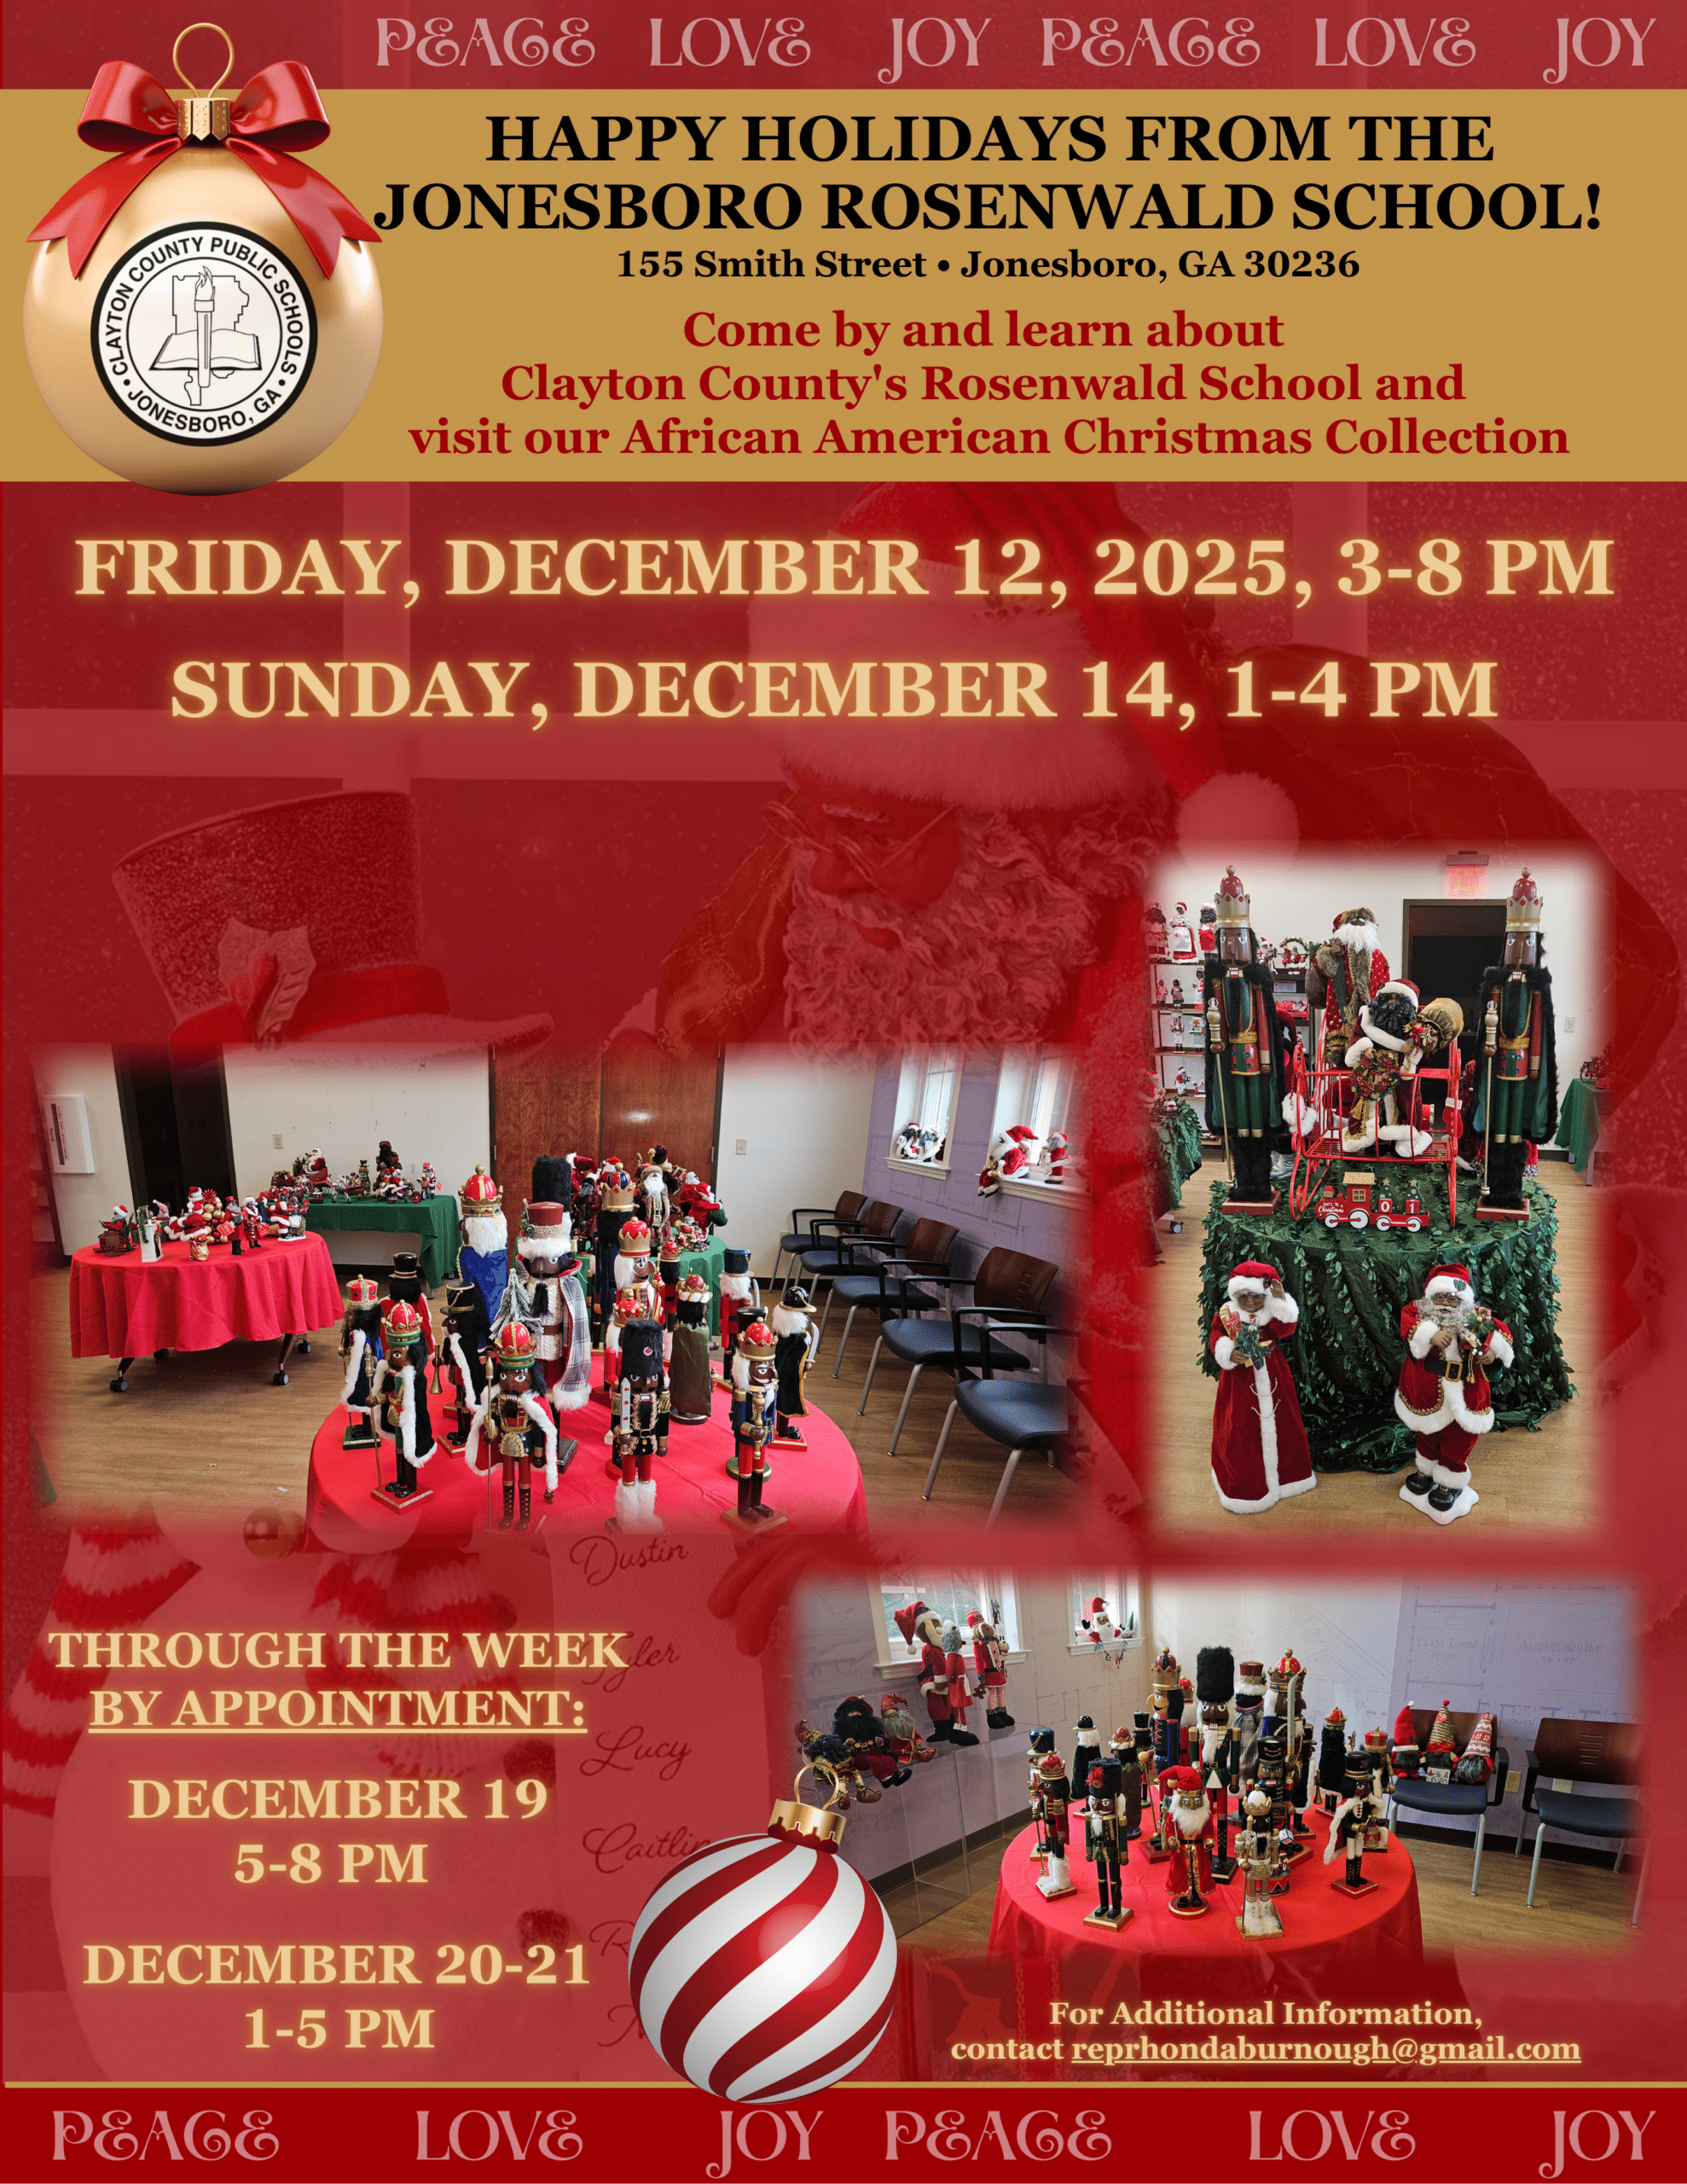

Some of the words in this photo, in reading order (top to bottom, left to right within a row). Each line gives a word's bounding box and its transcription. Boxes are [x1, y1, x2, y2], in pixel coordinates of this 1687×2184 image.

[377, 18, 594, 67] PEACE
[651, 18, 810, 67] LOVE
[878, 18, 991, 84] JOY
[1042, 18, 1260, 67] PEACE
[1316, 18, 1475, 67] LOVE
[1543, 18, 1656, 84] JOY
[486, 116, 726, 160] HAPPY
[742, 115, 1105, 161] HOLIDAYS
[1127, 115, 1330, 161] FROM
[1349, 117, 1493, 160] THE
[374, 183, 802, 229] JONESBORO
[822, 183, 1273, 229] ROSENWALD
[1293, 183, 1599, 229] SCHOOL!
[619, 251, 682, 276] 155
[695, 249, 804, 277] Smith
[816, 251, 926, 277] Street
[961, 249, 1167, 282] Jonesboro,
[1179, 251, 1235, 277] GA
[1245, 251, 1359, 277] 30236
[106, 282, 134, 375] CLAYTON
[128, 236, 204, 282] COUNTY
[210, 236, 278, 280] PUBLIC
[273, 279, 304, 375] SCHOOLS
[684, 312, 820, 346] Come
[832, 310, 890, 356] by
[903, 310, 993, 346] and
[1006, 310, 1133, 346] learn
[1147, 310, 1284, 346] about
[502, 363, 685, 410] Clayton
[699, 364, 907, 410] County's
[922, 363, 1186, 400] Rosenwald
[1200, 363, 1361, 400] School
[1377, 363, 1466, 400] and
[127, 390, 254, 433] JONESBORO,
[253, 388, 282, 414] GA
[409, 417, 511, 454] visit
[525, 429, 610, 454] our
[621, 417, 802, 454] African
[813, 417, 1050, 454] American
[1064, 417, 1312, 454] Christmas
[1326, 417, 1569, 454] Collection
[76, 540, 419, 607] FRIDAY,
[446, 539, 929, 595] DECEMBER
[955, 540, 1066, 607] 12,
[1095, 540, 1311, 607] 2025,
[1339, 539, 1461, 595] 3-8
[1487, 541, 1613, 594] PM
[173, 662, 547, 729] SUNDAY,
[575, 662, 1057, 717] DECEMBER
[1084, 662, 1194, 729] 14,
[1228, 662, 1346, 716] 1-4
[1371, 663, 1497, 716] PM
[1381, 1201, 1390, 1212] 0
[1410, 1203, 1415, 1214] 1
[569, 1535, 690, 1587] Dustin
[49, 1633, 325, 1668] THROUGH
[340, 1634, 449, 1667] THE
[464, 1634, 628, 1667] WEEK
[91, 1692, 161, 1725] BY
[172, 1691, 583, 1726] APPOINTMENT:
[579, 1725, 693, 1781] Lucy
[130, 1780, 467, 1819] DECEMBER
[486, 1780, 546, 1818] 19
[235, 1844, 321, 1883] 5-8
[339, 1845, 427, 1882] PM
[84, 1945, 421, 1984] DECEMBER
[437, 1945, 588, 1984] 20-21
[246, 2009, 326, 2048] 1-5
[345, 2010, 433, 2048] PM
[1051, 2002, 1104, 2024] For
[1112, 2001, 1273, 2024] Additional
[1283, 2001, 1482, 2030] Information,
[951, 2039, 1064, 2060] contact
[1071, 2036, 1582, 2065] reprhondaburnough@gmail.com
[54, 2111, 279, 2160] PEACE
[417, 2111, 583, 2160] LOVE
[706, 2111, 823, 2178] JOY
[886, 2111, 1111, 2160] PEACE
[1249, 2111, 1415, 2160] LOVE
[1539, 2111, 1655, 2178] JOY
